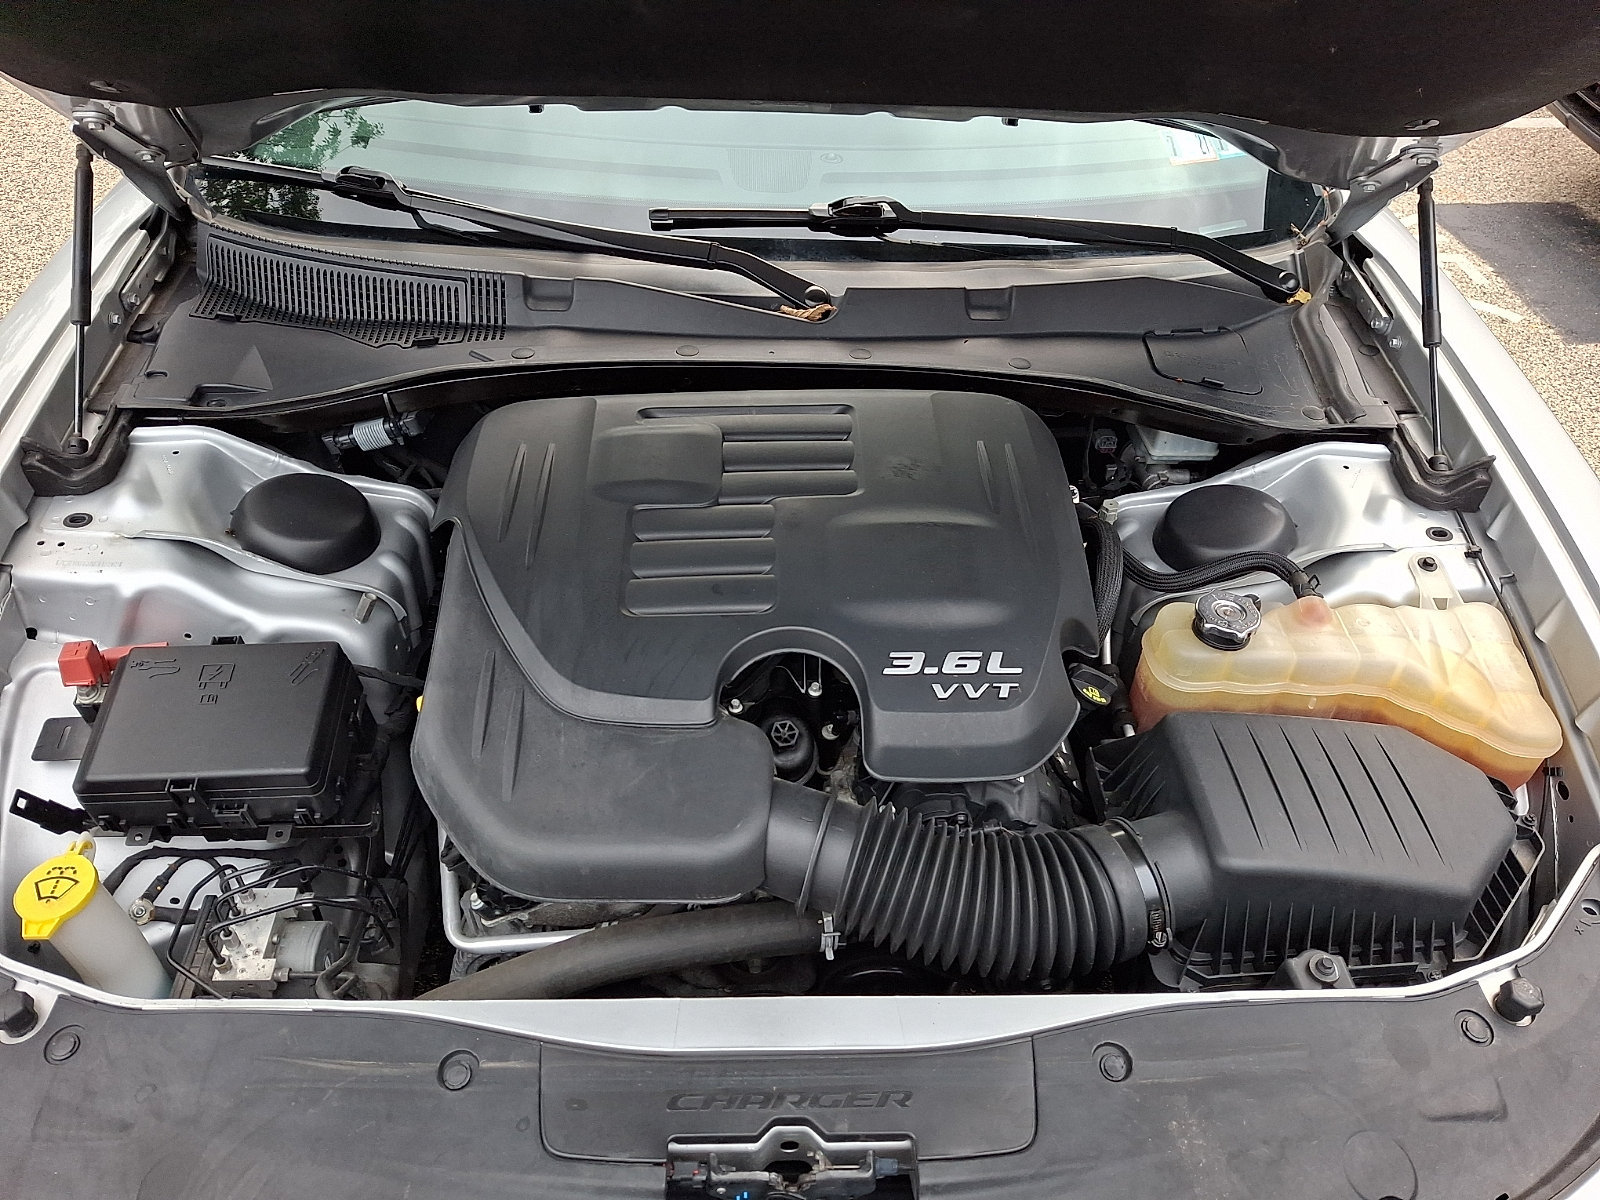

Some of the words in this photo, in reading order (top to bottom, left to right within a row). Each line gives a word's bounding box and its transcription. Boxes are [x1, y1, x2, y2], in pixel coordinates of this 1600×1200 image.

[882, 651, 1023, 675] 3.6L
[931, 683, 1020, 699] VVT
[666, 1090, 914, 1112] CHARGER
